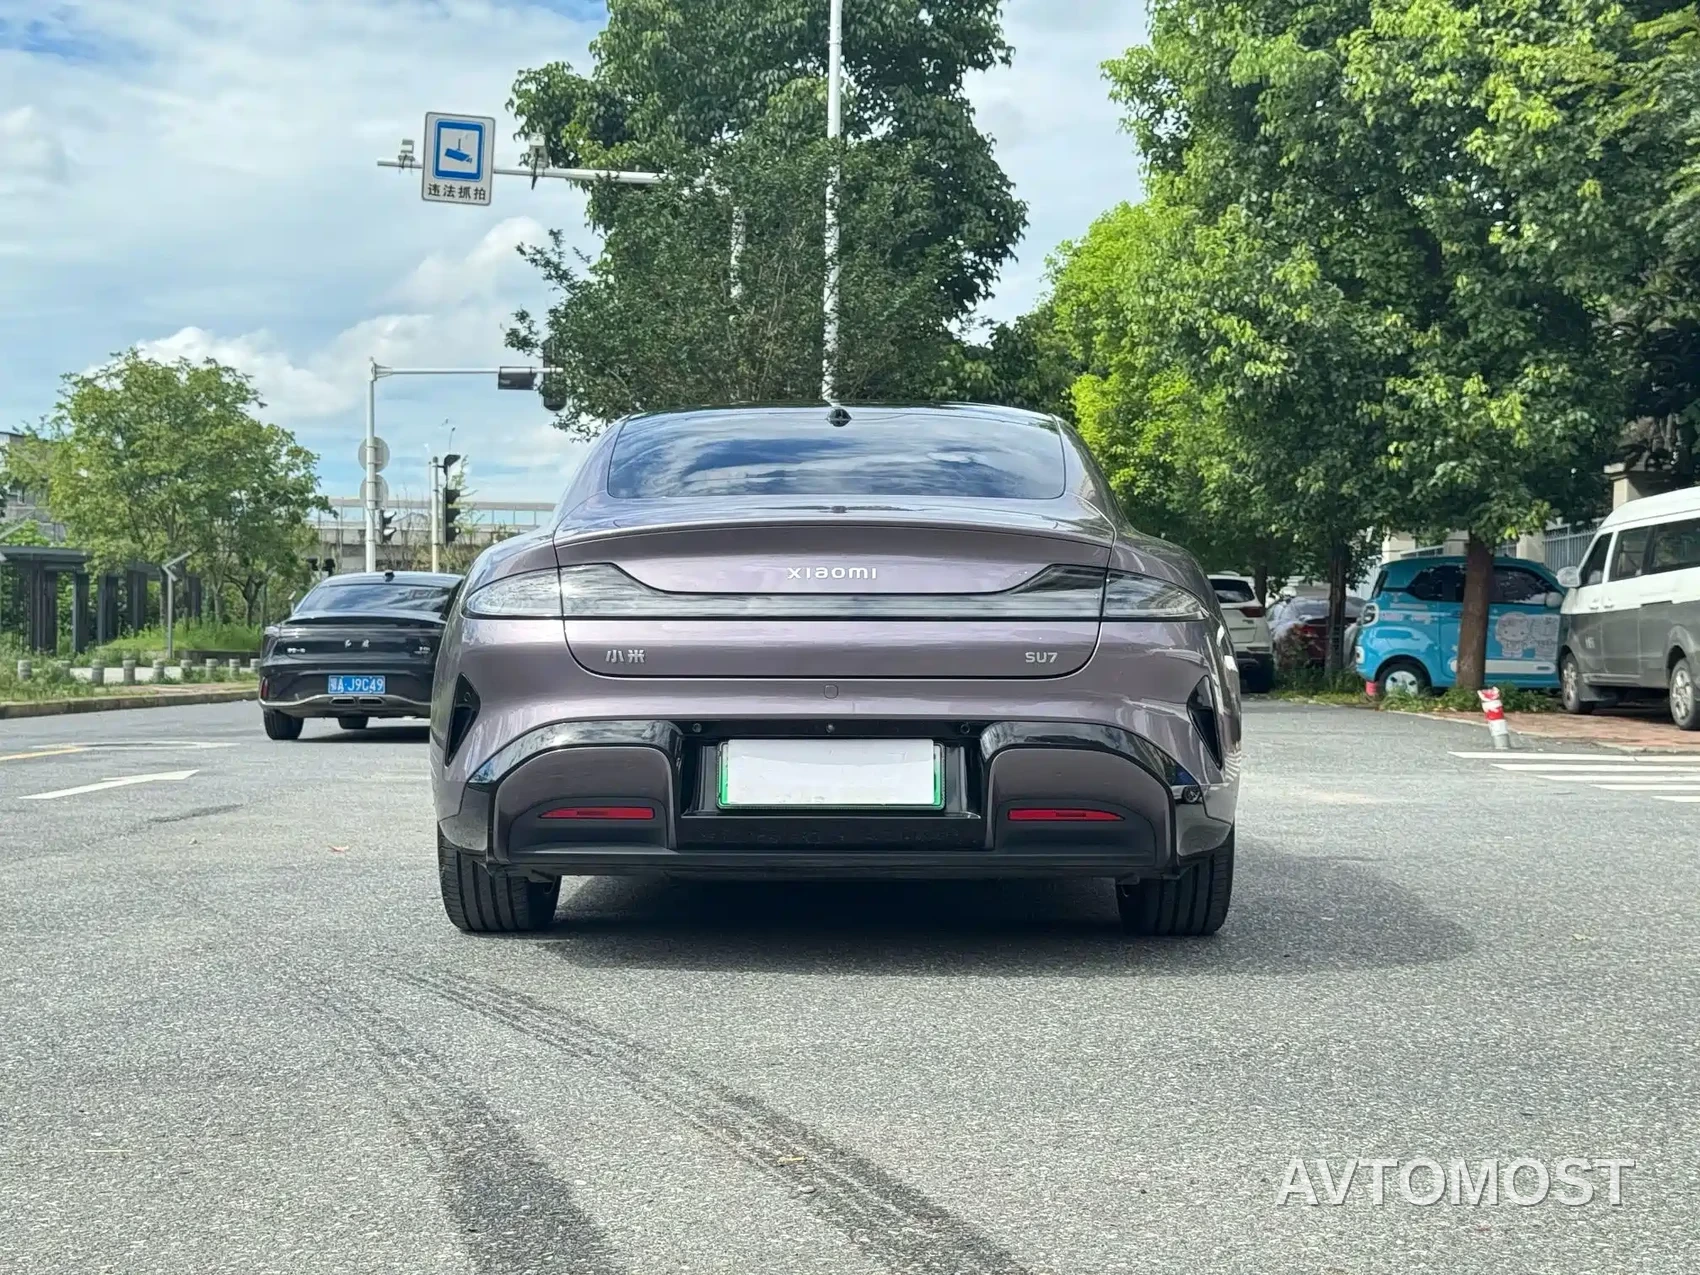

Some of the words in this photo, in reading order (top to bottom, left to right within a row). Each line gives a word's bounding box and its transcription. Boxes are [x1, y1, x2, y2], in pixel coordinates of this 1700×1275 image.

[428, 183, 486, 200] 违法抓拍
[605, 649, 645, 663] 小米
[1025, 651, 1058, 663] SU7
